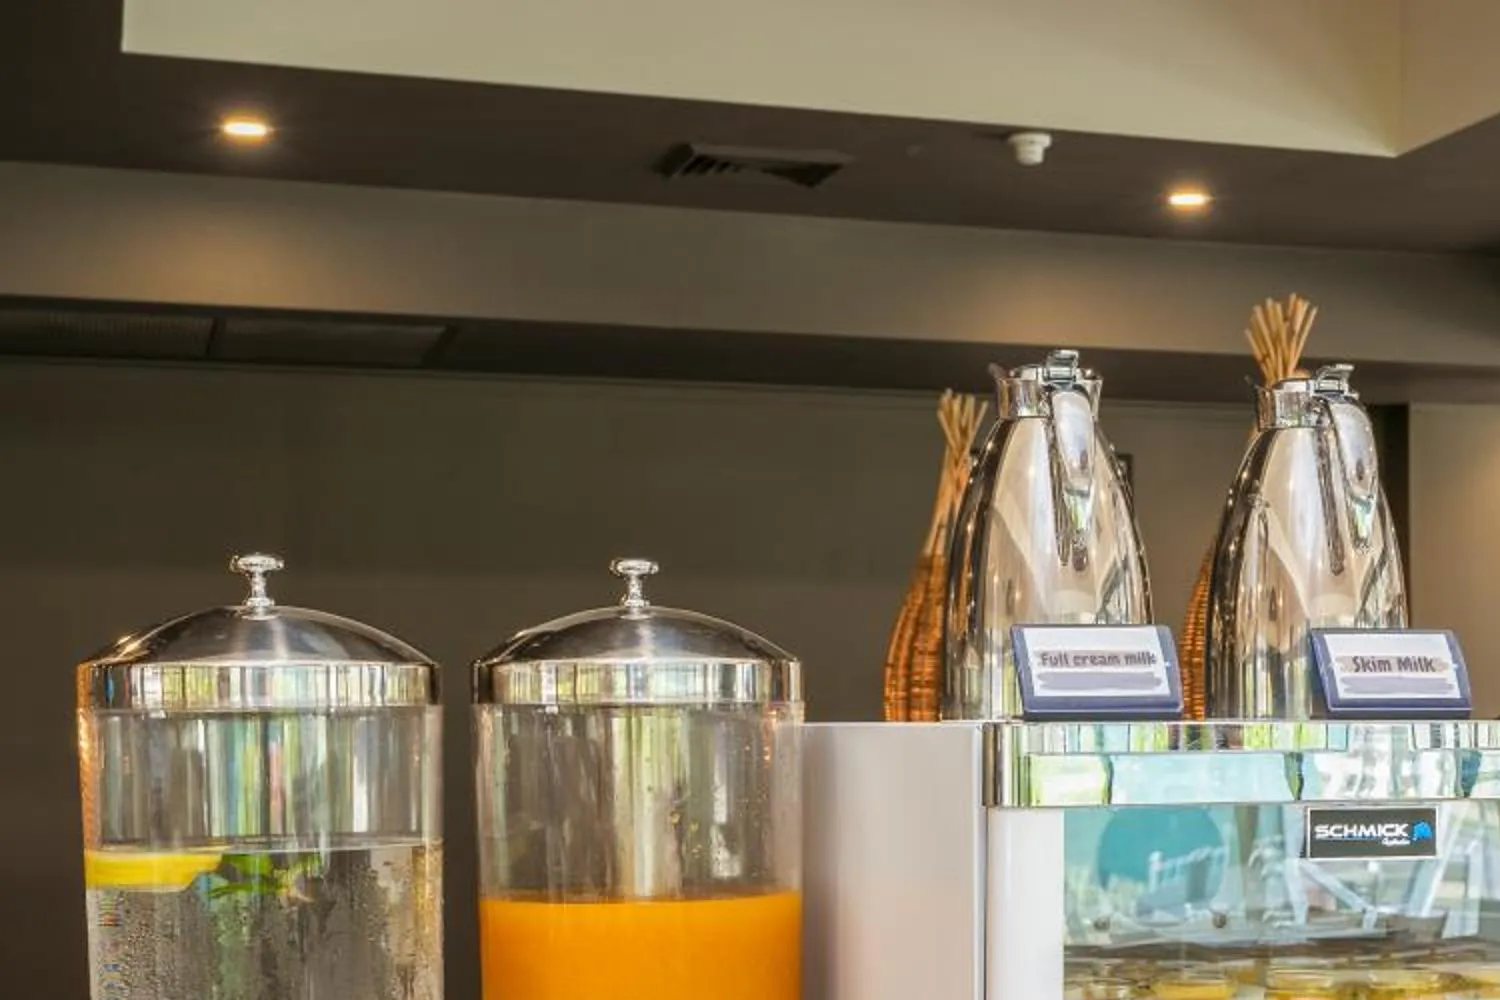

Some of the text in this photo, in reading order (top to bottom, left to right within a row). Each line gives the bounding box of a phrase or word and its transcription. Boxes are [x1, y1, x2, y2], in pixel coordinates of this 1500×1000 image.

[1040, 651, 1157, 667] Full cream milk
[1351, 655, 1436, 673] Skim Milk
[1314, 823, 1409, 839] SCHMICK
